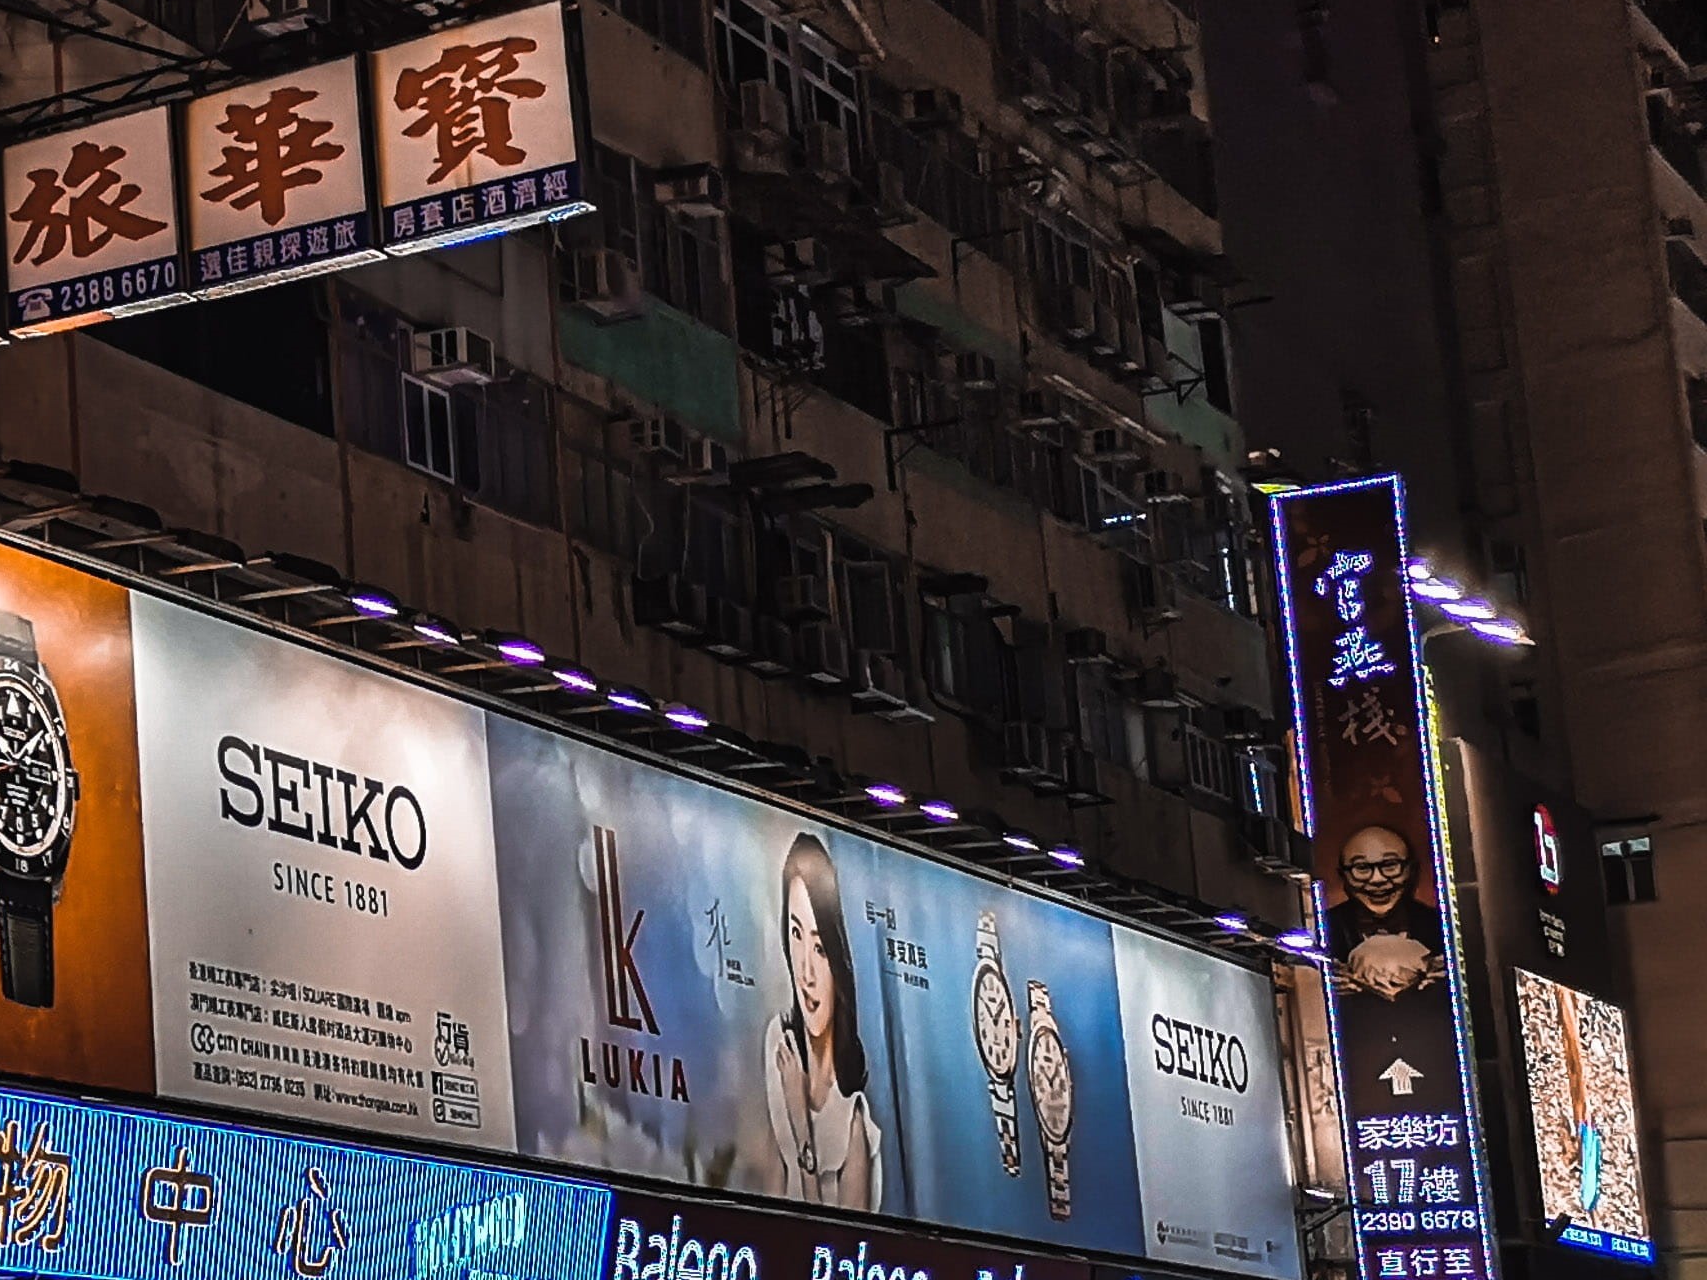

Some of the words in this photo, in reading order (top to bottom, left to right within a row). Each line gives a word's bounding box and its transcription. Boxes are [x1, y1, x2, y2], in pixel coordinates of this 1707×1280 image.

[61, 279, 116, 312] 2388
[121, 262, 175, 302] 6670
[218, 737, 428, 871] SEIKO
[273, 862, 336, 905] SINCE
[344, 880, 389, 918] 1881
[217, 1037, 239, 1051] CITY
[240, 1038, 270, 1059] CHAIN
[580, 1038, 690, 1104] LUKIA
[1152, 1013, 1248, 1094] SEIKO
[1181, 1096, 1210, 1123] SINCE
[1213, 1104, 1234, 1126] 1881
[1357, 1116, 1460, 1149] 家樂坊
[412, 1195, 524, 1279] HOLLYWOOD
[1421, 1210, 1476, 1229] 6678
[1377, 1249, 1472, 1276] 直行至
